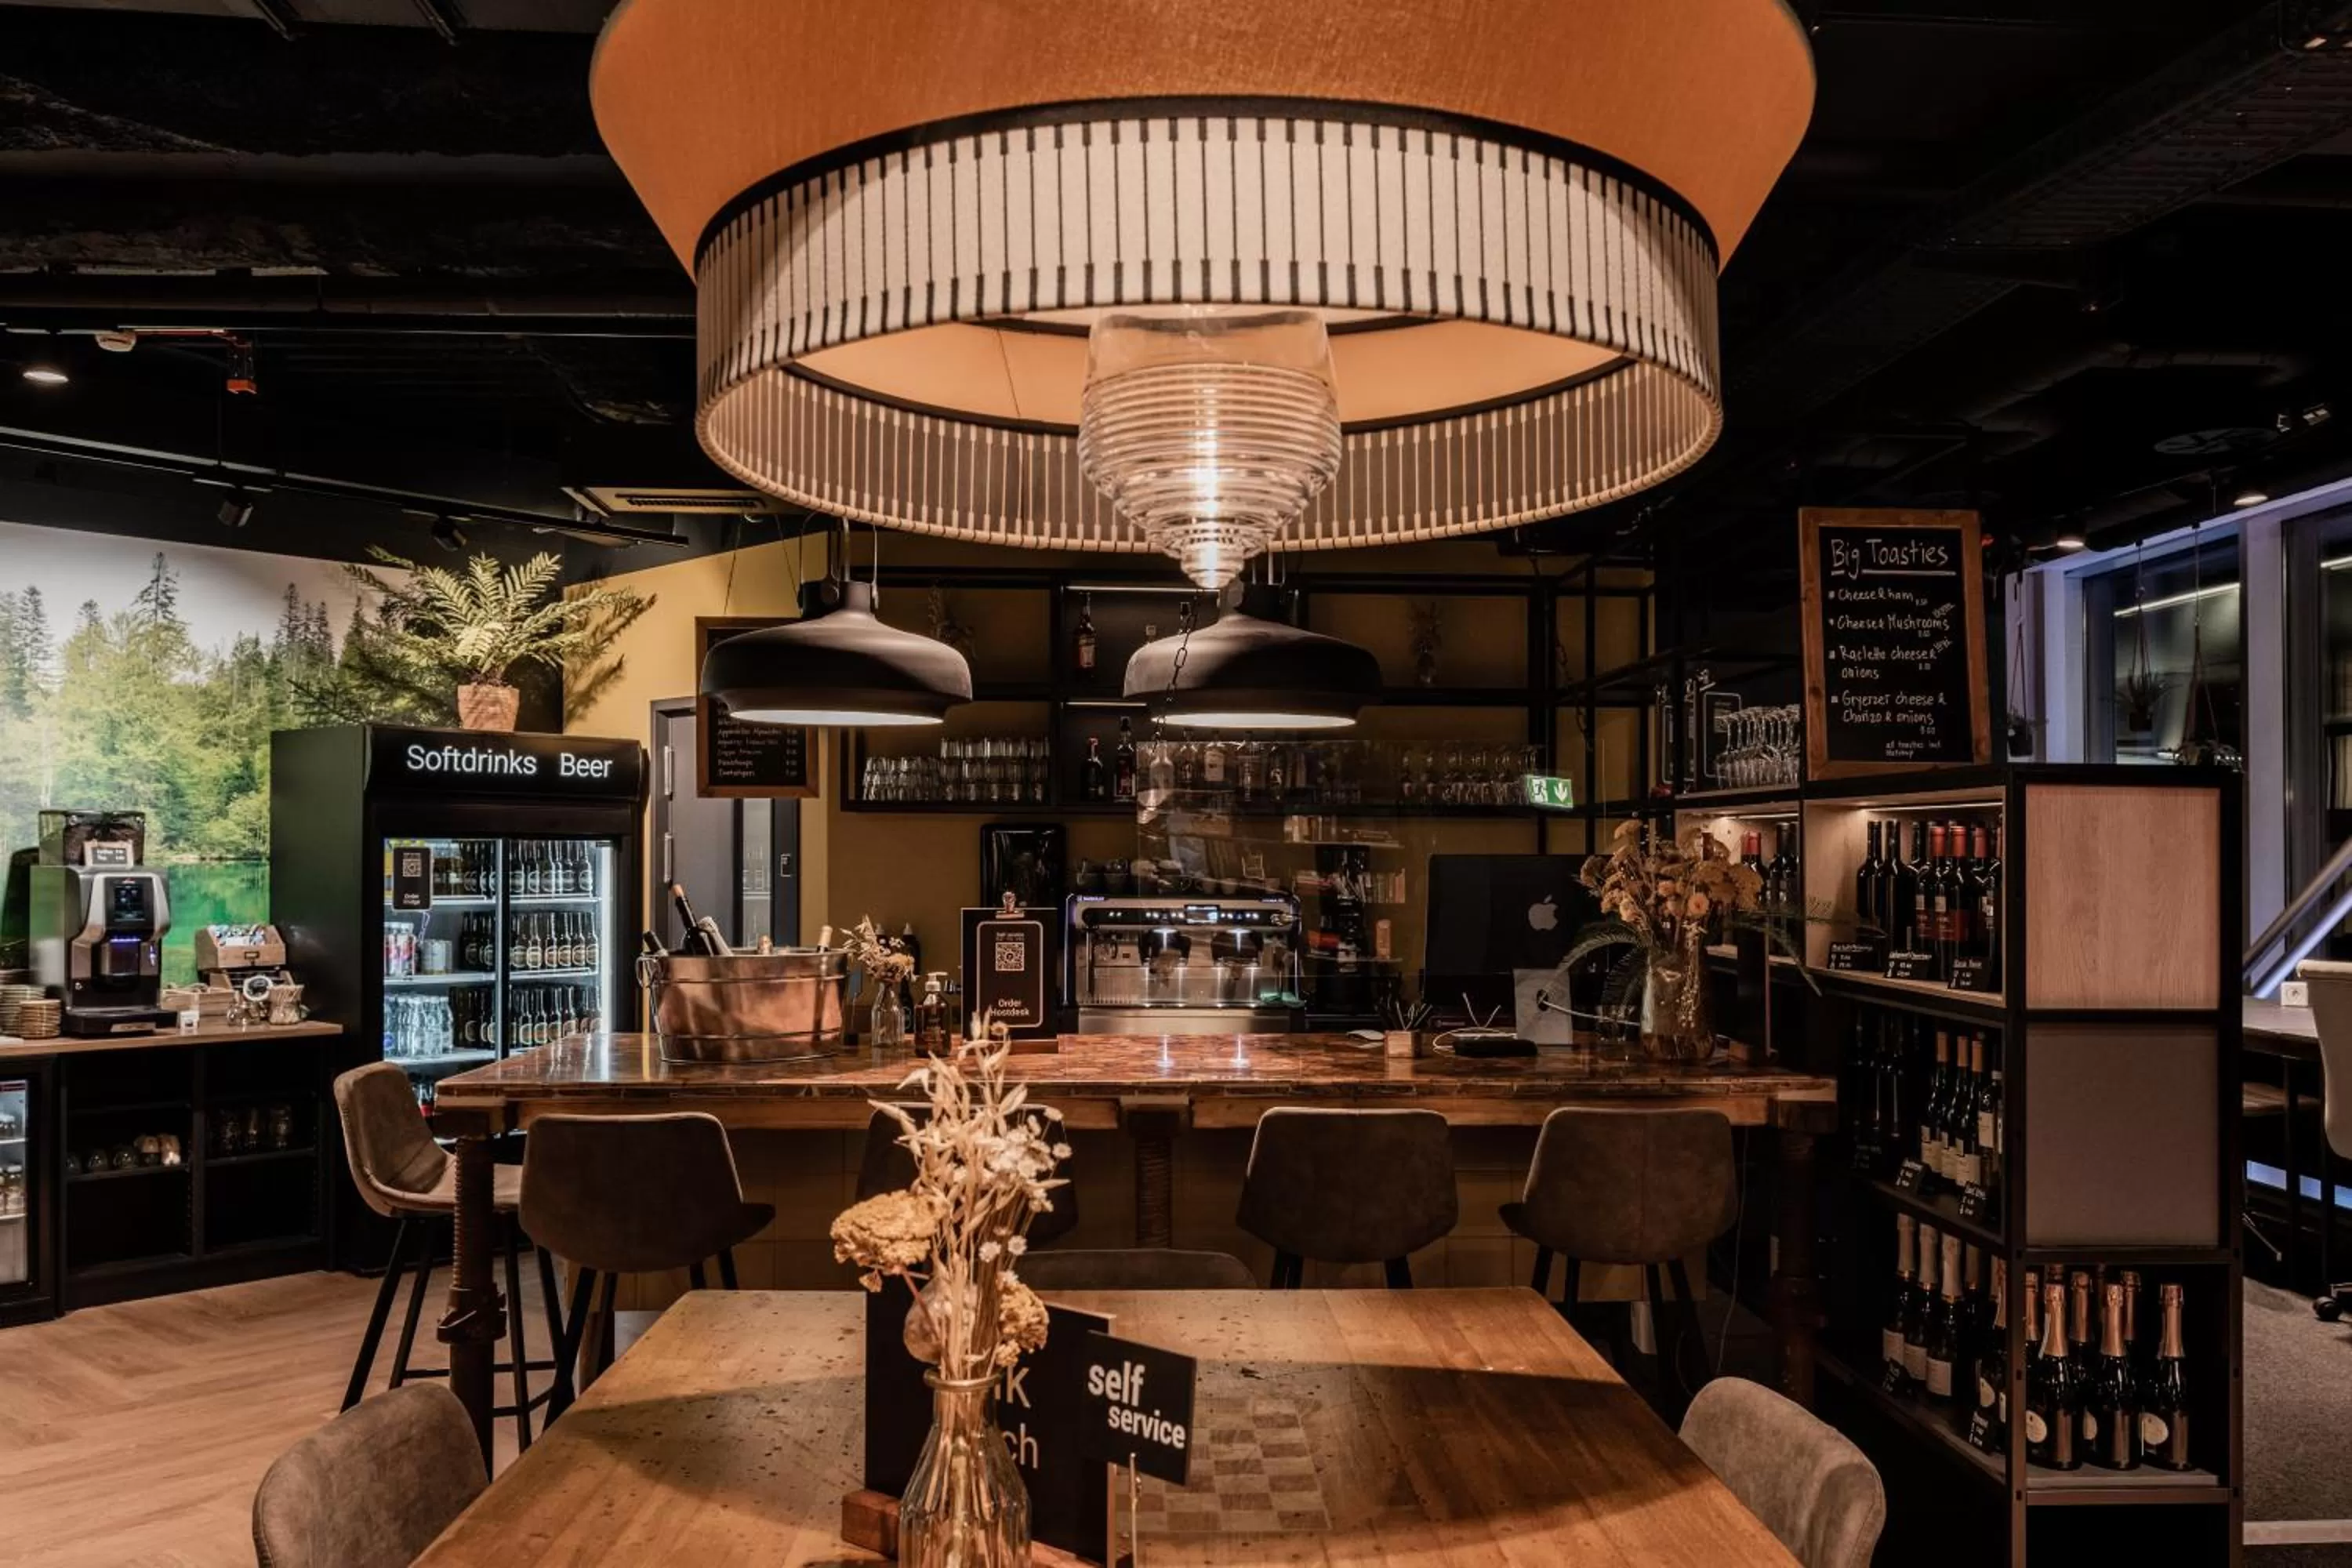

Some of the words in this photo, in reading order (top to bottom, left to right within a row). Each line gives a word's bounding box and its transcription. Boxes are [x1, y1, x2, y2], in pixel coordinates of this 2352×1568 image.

[1831, 539, 1860, 580] Big
[1865, 539, 1949, 566] Toasties
[1838, 588, 1877, 601] Cheese
[1887, 587, 1914, 602] ham
[1887, 613, 1950, 631] Mushrooms
[1838, 644, 1886, 662] Raclette
[1890, 645, 1927, 660] cheese
[1842, 666, 1879, 679] onions
[1895, 691, 1934, 706] cheese
[1896, 710, 1934, 725] onions
[407, 745, 538, 775] Softdrinks
[560, 753, 613, 778] Beer
[998, 998, 1022, 1007] Order
[1087, 1360, 1146, 1407] self
[1107, 1406, 1187, 1449] service
